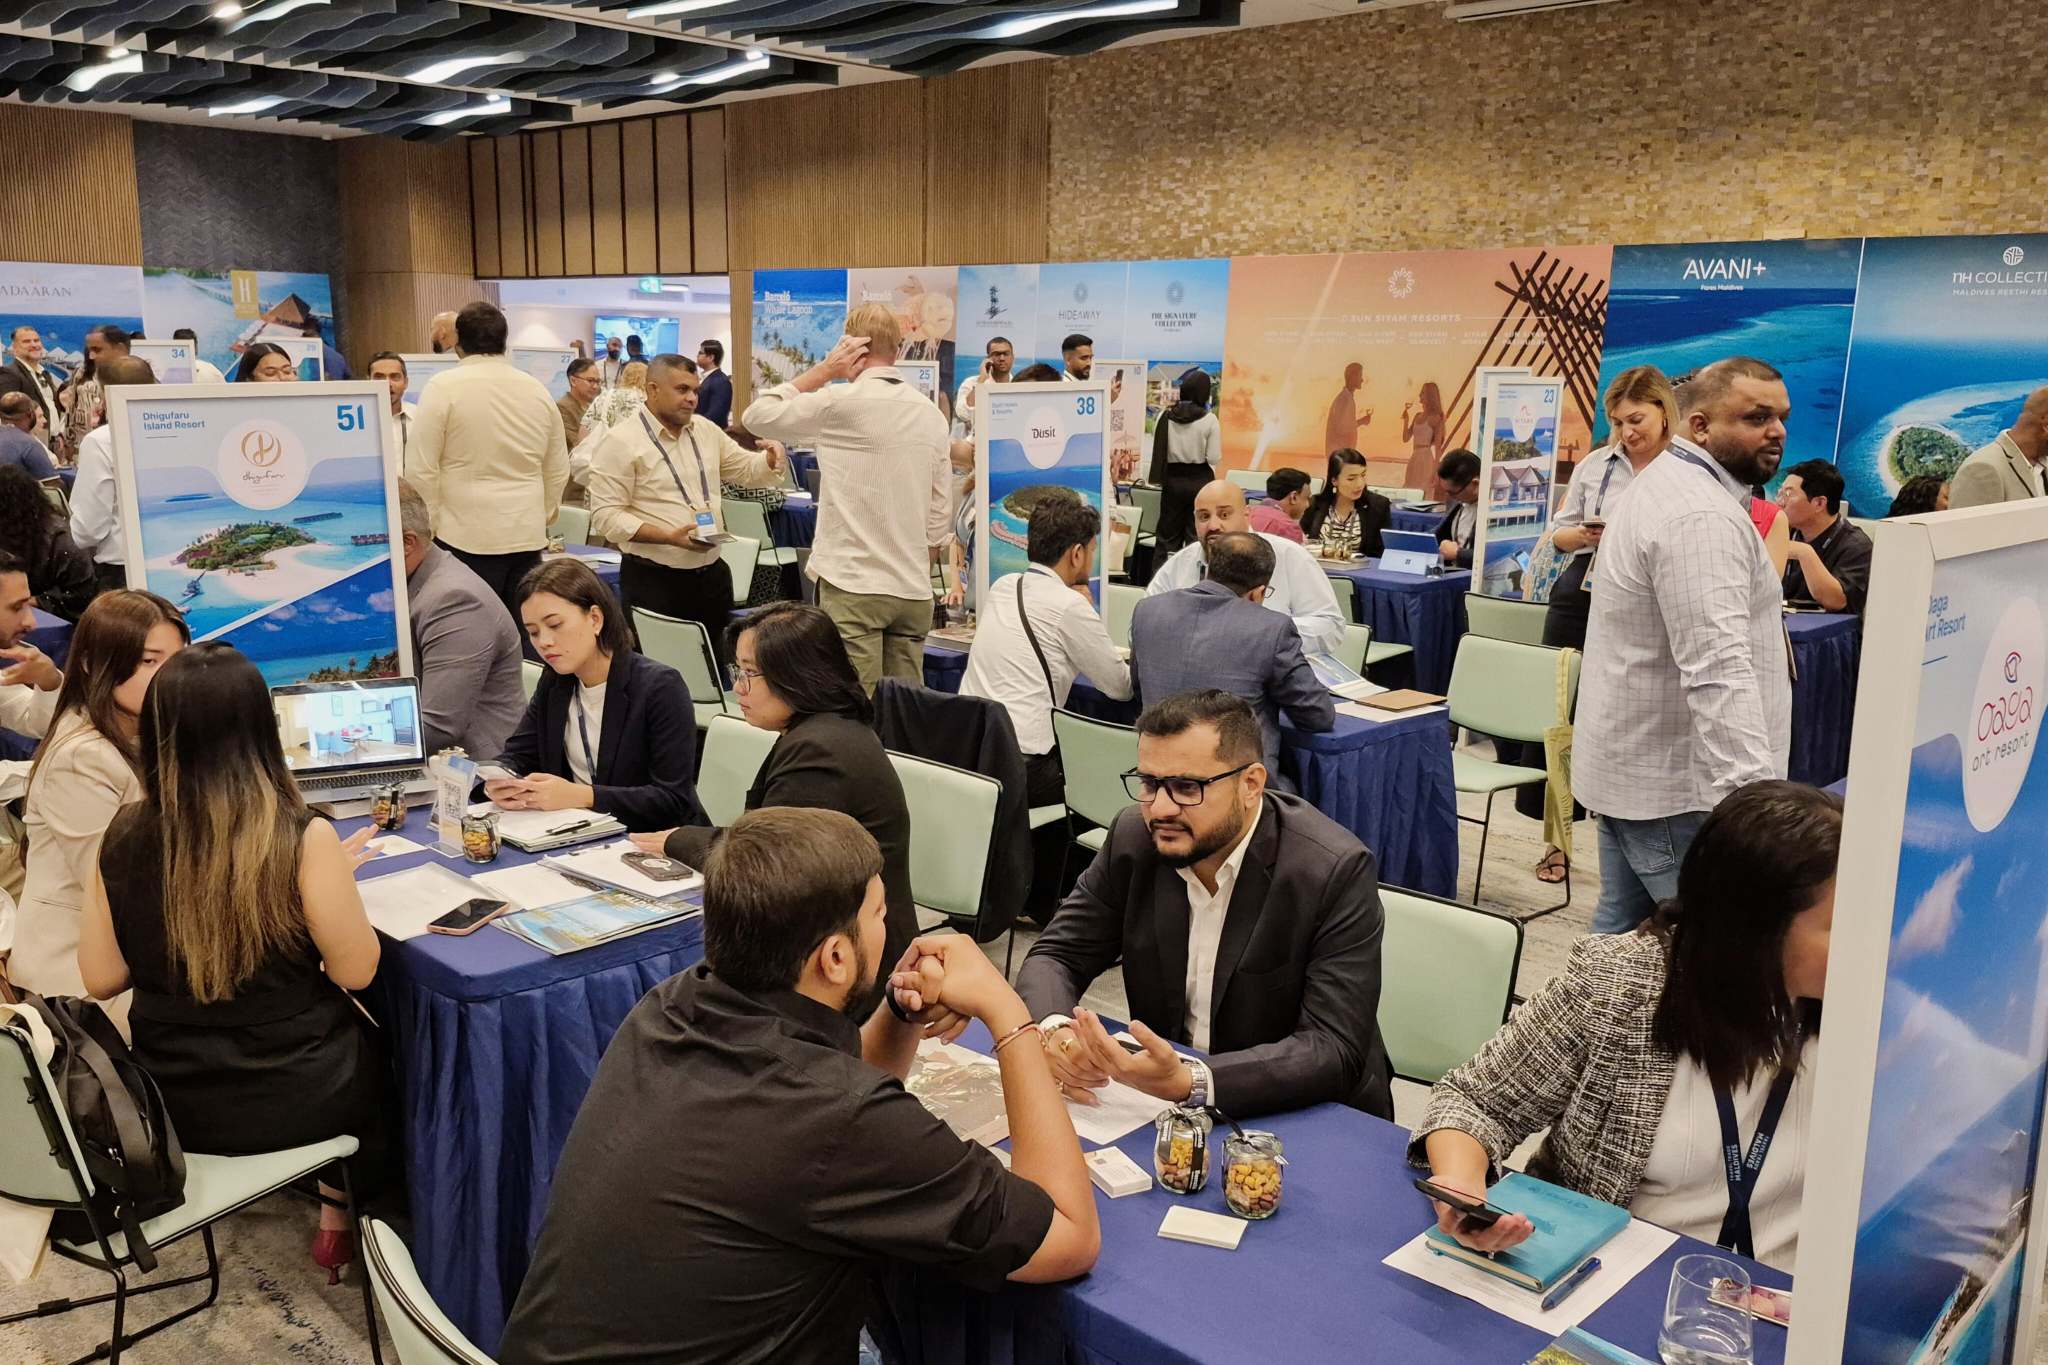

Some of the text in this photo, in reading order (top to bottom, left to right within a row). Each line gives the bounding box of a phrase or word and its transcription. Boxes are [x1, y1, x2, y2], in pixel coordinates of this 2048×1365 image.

[1682, 258, 1767, 280] AVANI+
[1058, 310, 1102, 320] HIDEAWAY
[919, 369, 931, 380] 25
[1076, 396, 1096, 415] 38
[1543, 388, 1555, 404] 23
[143, 411, 190, 421] Dhigufaru
[144, 420, 206, 430] Island Resort
[336, 404, 366, 432] 51
[1031, 426, 1056, 439] Dusit
[1937, 612, 1967, 638] Resort
[1994, 732, 2030, 761] resort
[1746, 1132, 1765, 1169] MALDIVES
[1731, 1144, 1742, 1182] MALDIVES
